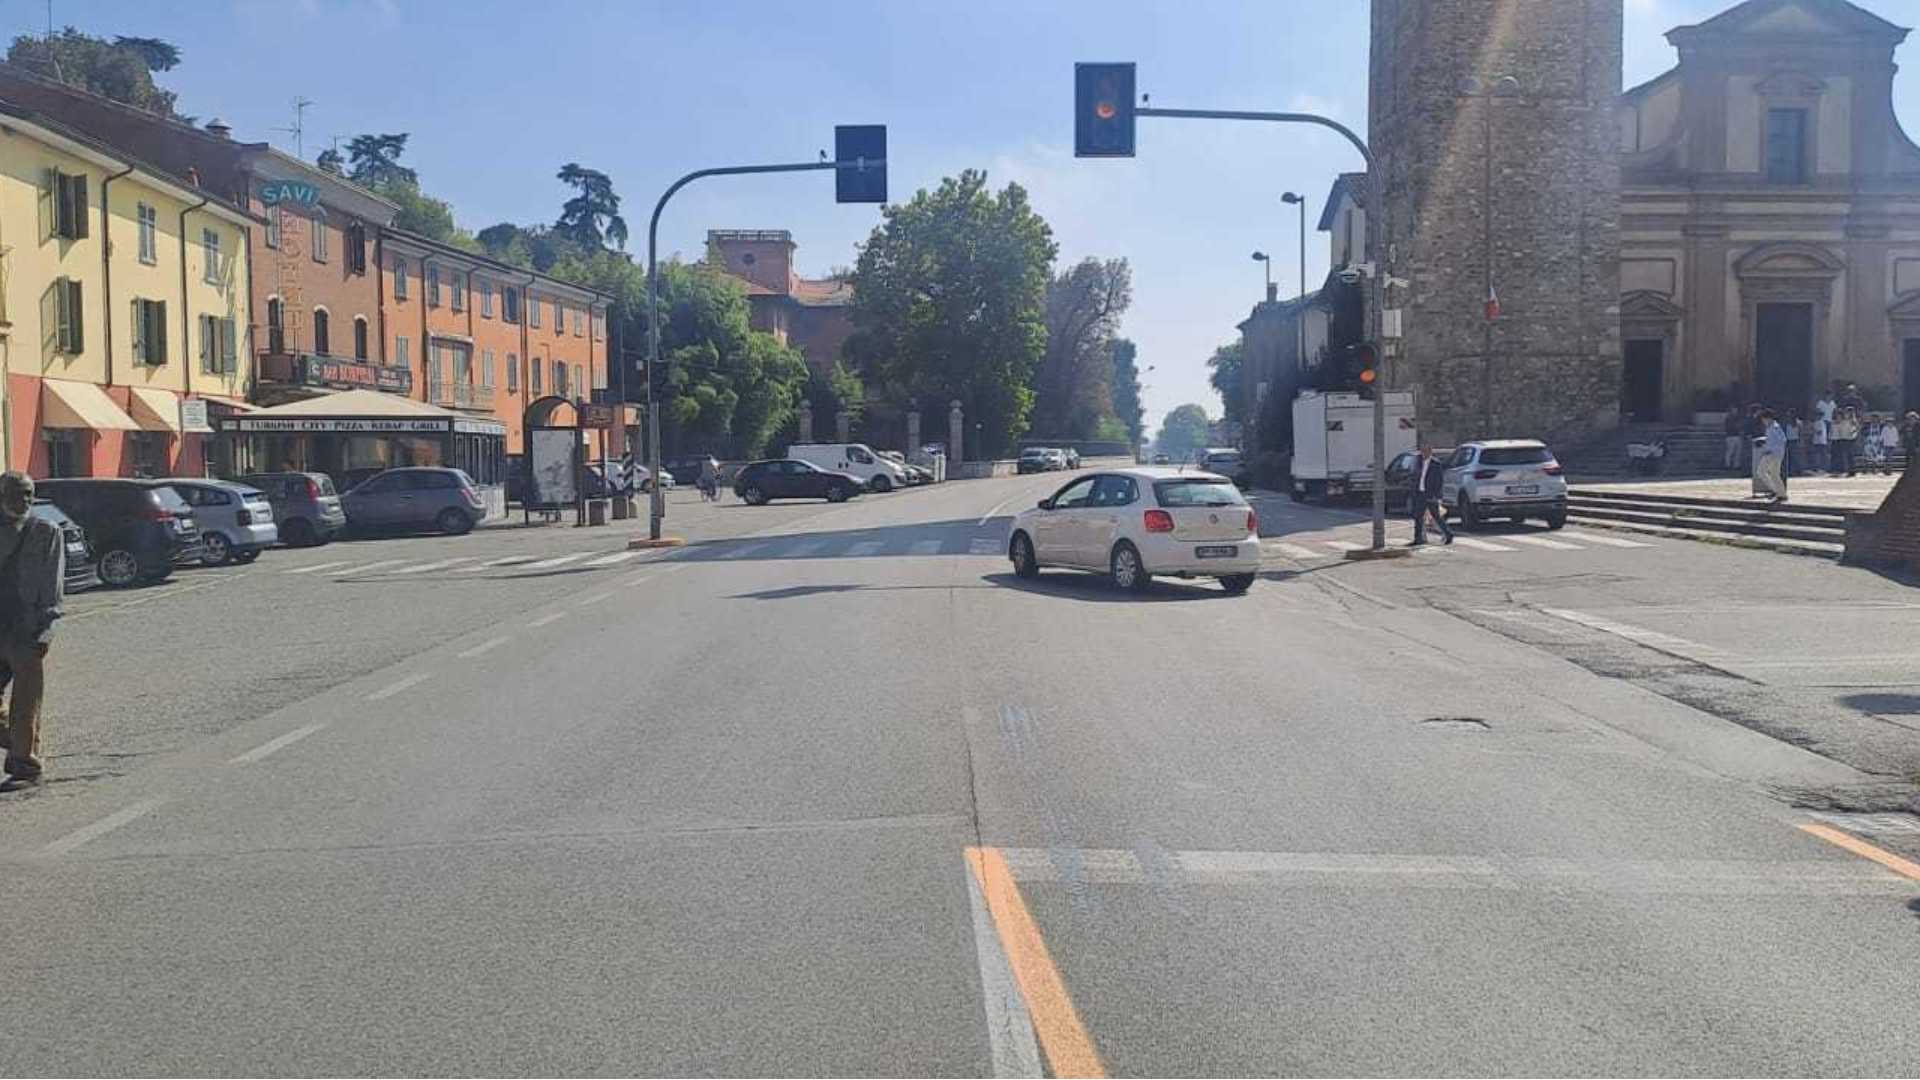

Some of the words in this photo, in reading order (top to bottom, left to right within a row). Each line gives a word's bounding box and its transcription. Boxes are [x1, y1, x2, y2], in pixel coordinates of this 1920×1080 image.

[263, 184, 314, 204] SAVI
[301, 421, 327, 430] CITY
[335, 421, 364, 430] PIZZA
[410, 421, 440, 430] GRILL
